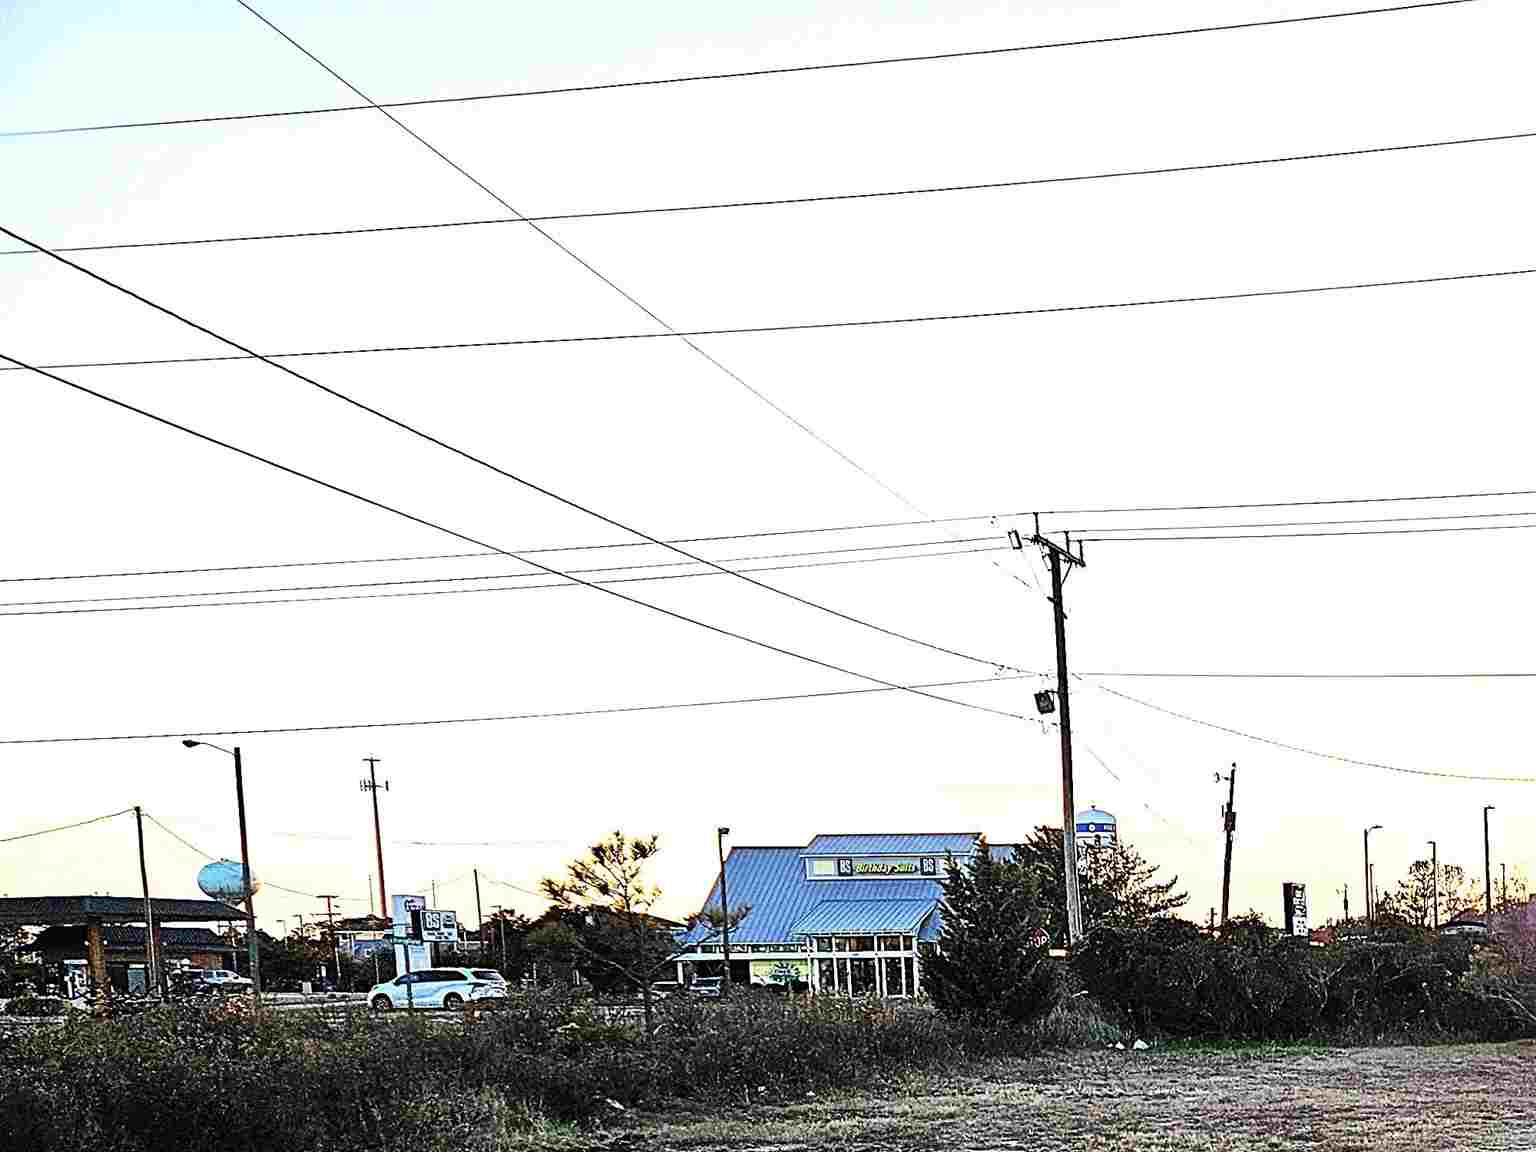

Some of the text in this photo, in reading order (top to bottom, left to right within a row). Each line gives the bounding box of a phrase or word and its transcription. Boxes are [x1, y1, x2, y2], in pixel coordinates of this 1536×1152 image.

[840, 858, 934, 874] BS Birthday Suits BS
